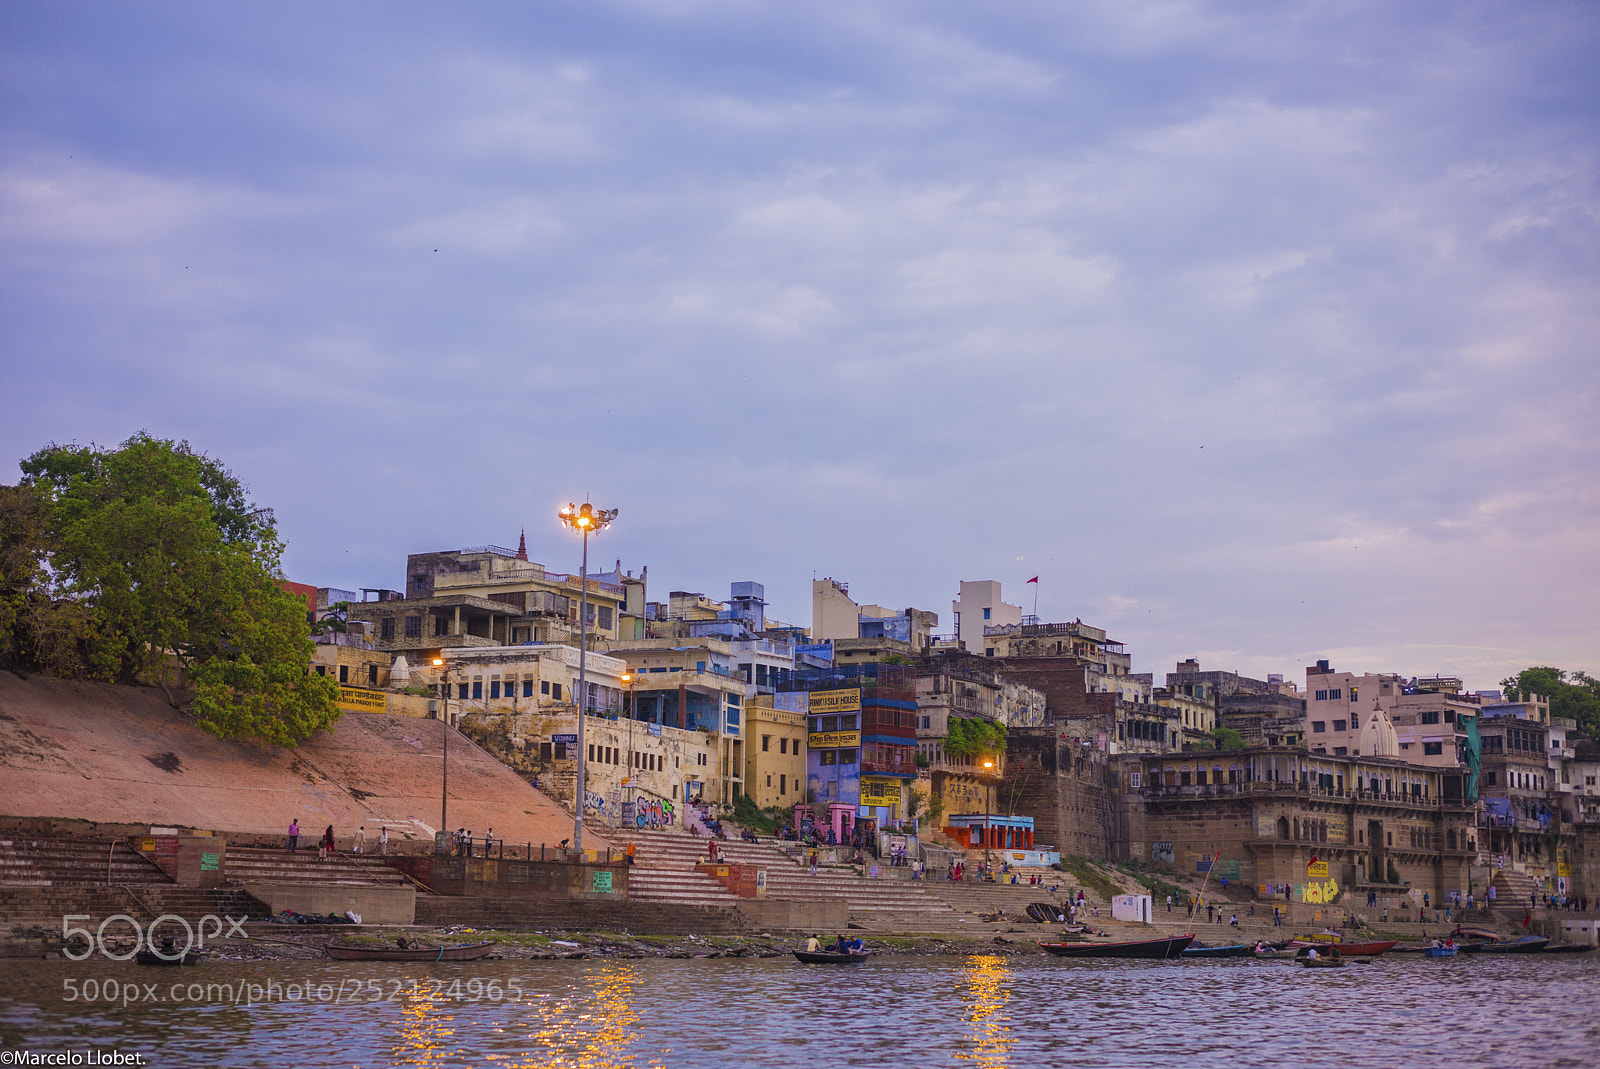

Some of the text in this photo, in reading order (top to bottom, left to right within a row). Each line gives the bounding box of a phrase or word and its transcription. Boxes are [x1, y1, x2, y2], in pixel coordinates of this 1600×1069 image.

[810, 695, 859, 707] RINKU SILK HOUSE
